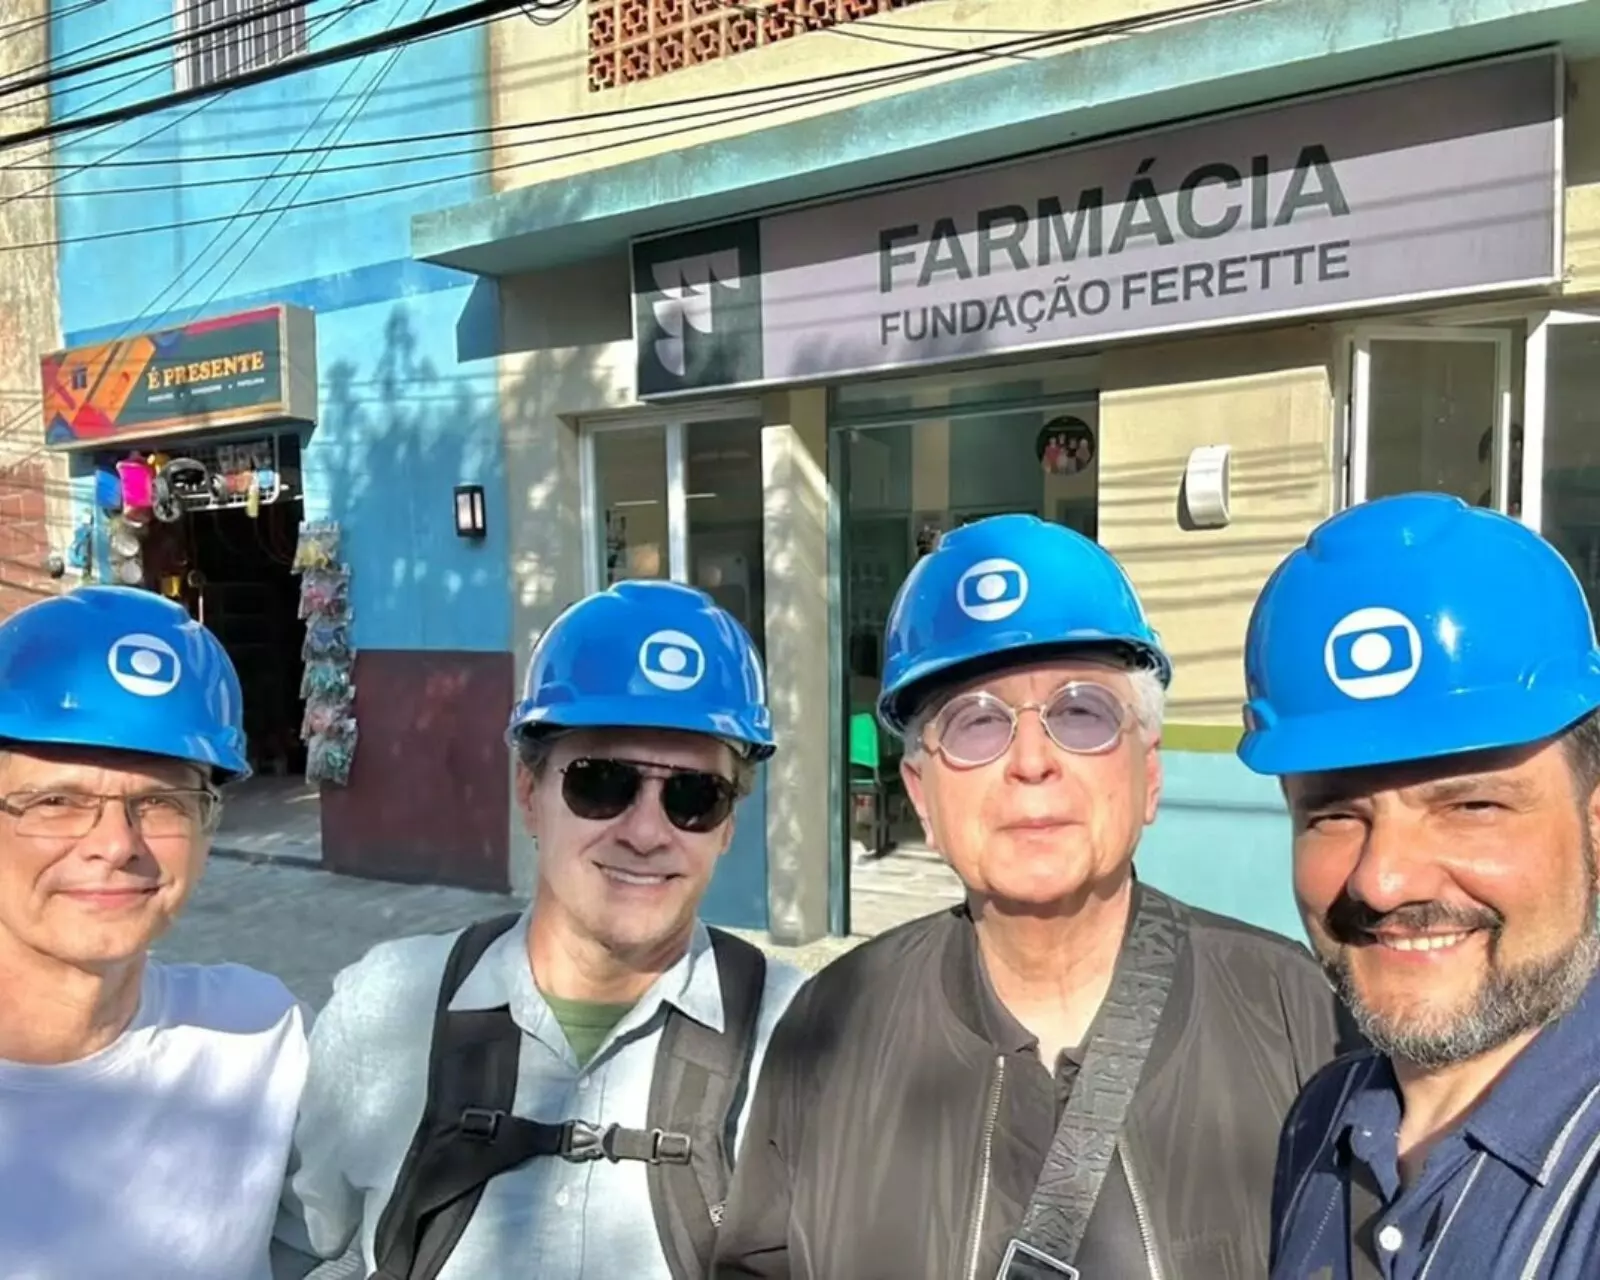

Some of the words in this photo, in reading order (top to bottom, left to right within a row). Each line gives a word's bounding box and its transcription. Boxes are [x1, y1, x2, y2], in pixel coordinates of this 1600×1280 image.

[879, 144, 1350, 293] FARMÁCIA
[881, 274, 1110, 345] FUNDAÇÃO
[1122, 240, 1350, 310] FERETTE
[147, 366, 160, 390] É
[163, 351, 265, 387] PRESENTE
